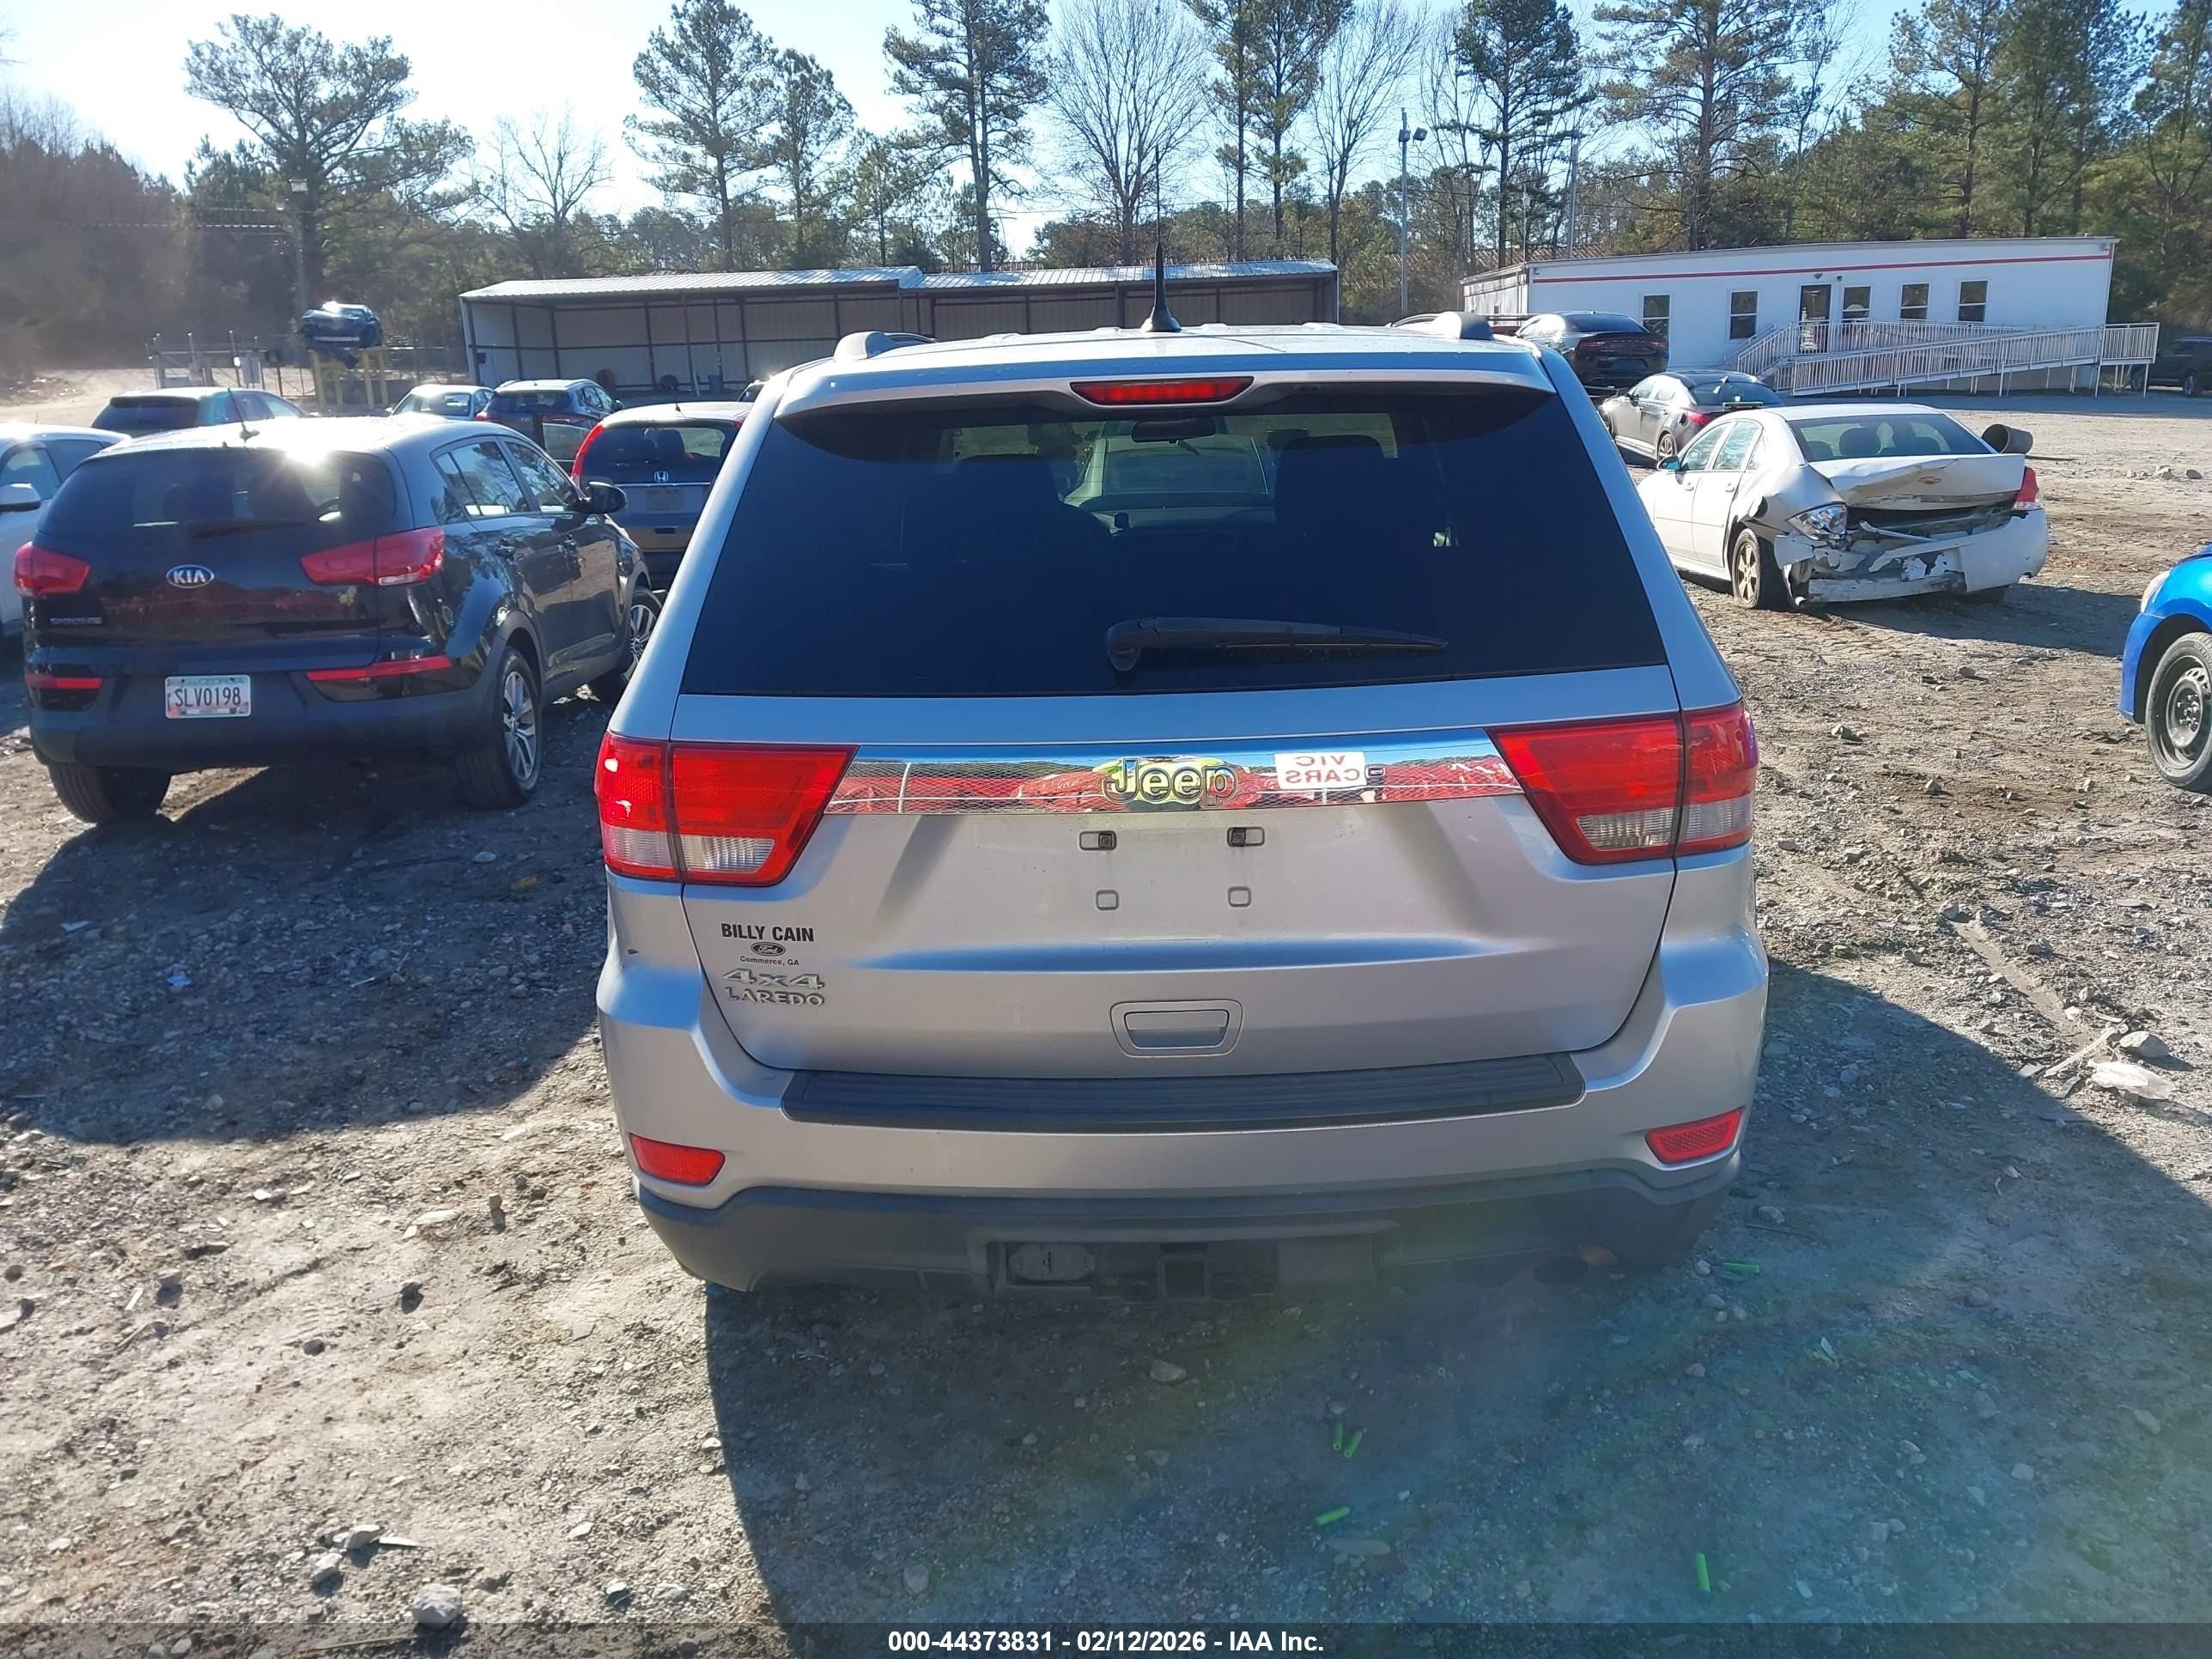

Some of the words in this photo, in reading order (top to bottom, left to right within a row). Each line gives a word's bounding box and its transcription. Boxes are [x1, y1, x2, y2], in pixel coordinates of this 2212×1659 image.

[173, 569, 206, 583] KIA
[1103, 757, 1237, 808] Jeep
[720, 922, 765, 940] BILLY
[772, 926, 814, 942] CAIN
[757, 945, 780, 954] Ford
[739, 955, 786, 966] Commerce,
[723, 968, 825, 990] 4x4
[725, 987, 825, 1006] LAREDO
